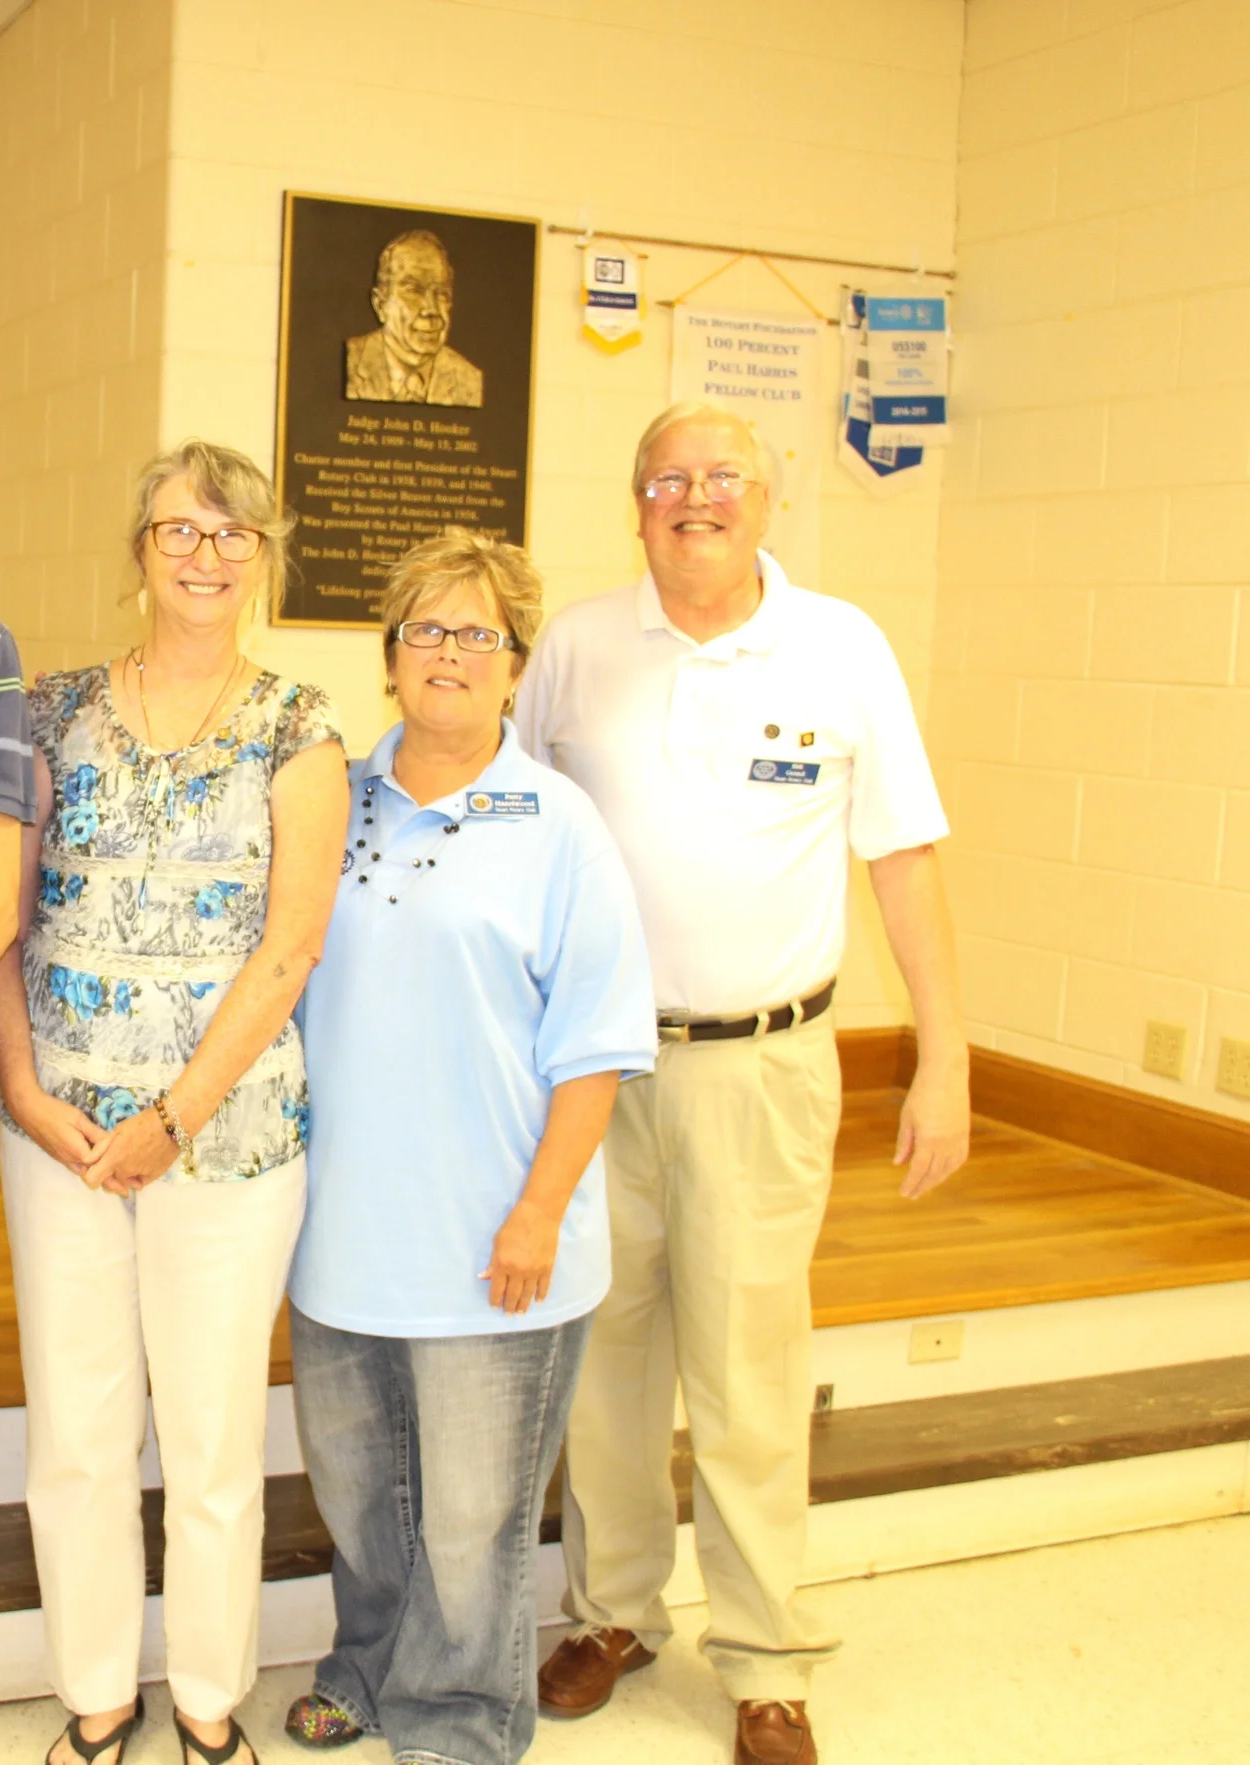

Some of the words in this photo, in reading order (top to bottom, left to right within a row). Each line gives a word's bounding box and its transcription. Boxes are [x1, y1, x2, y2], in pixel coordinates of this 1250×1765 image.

[711, 317, 750, 332] ROTARY
[706, 335, 733, 350] 100
[738, 339, 801, 356] PERCENT
[708, 359, 743, 375] PAUL
[747, 363, 798, 379] HARRIS
[704, 381, 760, 397] FELLOW
[762, 387, 802, 400] CLUB
[347, 414, 380, 431] Judge
[383, 416, 410, 432] John
[430, 421, 470, 436] Hooker
[338, 432, 360, 446] May
[413, 437, 434, 452] May
[293, 452, 331, 466] Charter
[333, 456, 371, 469] member
[373, 459, 390, 470] and
[393, 459, 413, 472] first
[414, 460, 458, 475] President
[459, 464, 471, 475] of
[472, 466, 488, 477] the
[490, 466, 518, 479] Stuart
[318, 469, 350, 484] Rotary
[353, 471, 377, 485] Club
[378, 473, 390, 485] in
[448, 478, 467, 490] and
[305, 484, 349, 498] Received
[351, 486, 368, 499] the
[370, 487, 398, 501] Silver
[434, 493, 464, 505] Award
[465, 494, 488, 507] from
[490, 496, 506, 508] the
[331, 501, 350, 515] Boy
[353, 502, 386, 516] Scouts
[387, 505, 399, 517] of
[401, 505, 440, 519] America
[301, 515, 322, 527] Was
[323, 518, 370, 530] presented
[371, 519, 388, 531] the
[389, 520, 411, 533] Paul
[361, 534, 374, 546] by
[375, 534, 408, 549] Rotary
[301, 546, 321, 558] The
[322, 547, 346, 559] John
[362, 549, 397, 561] Hooker
